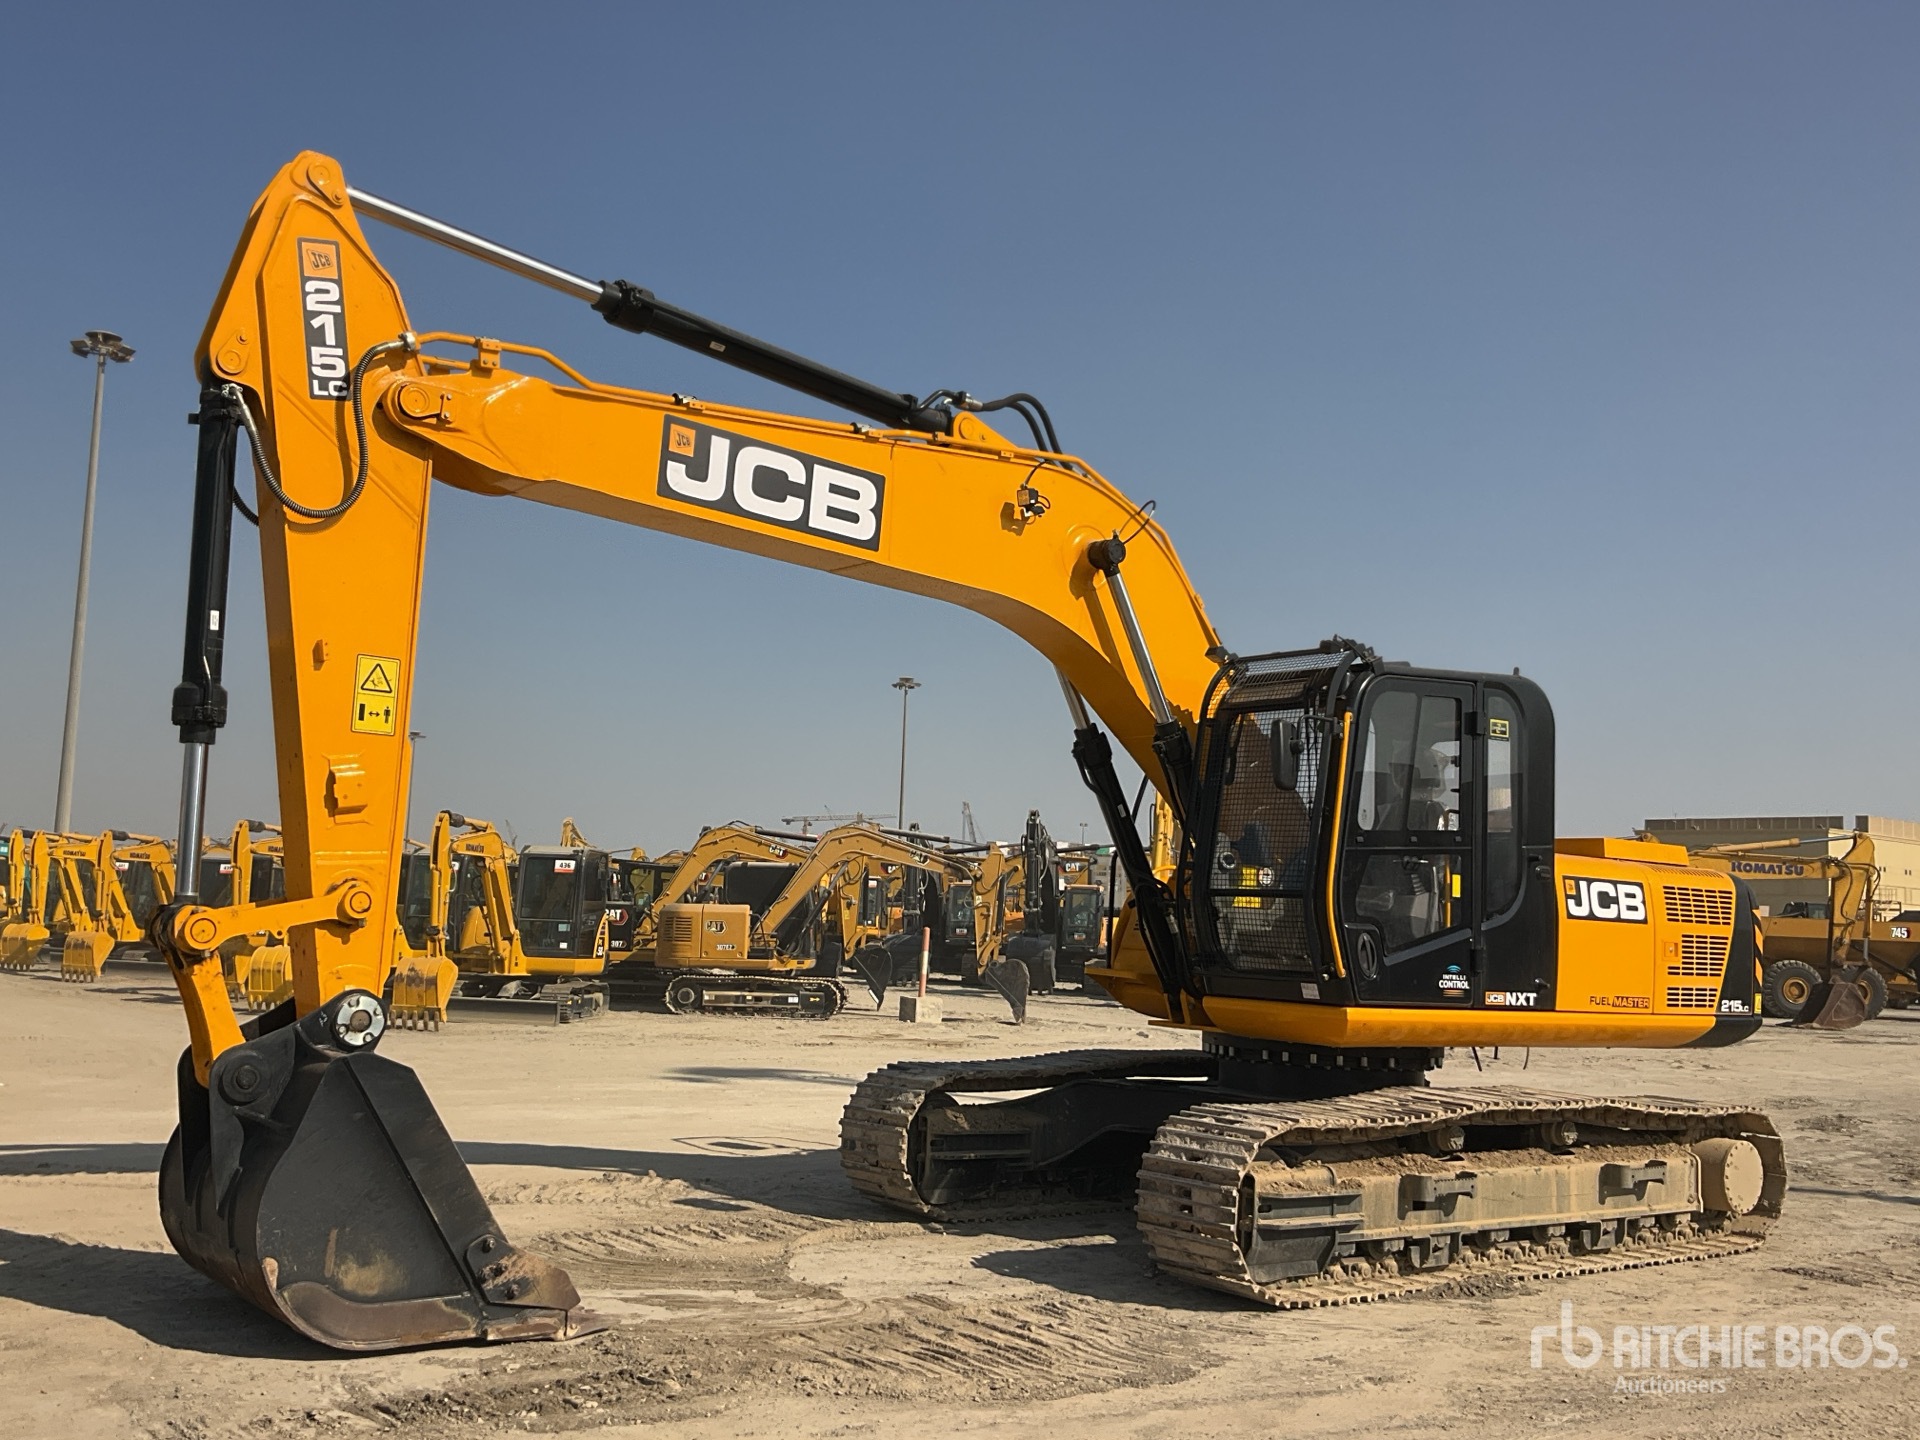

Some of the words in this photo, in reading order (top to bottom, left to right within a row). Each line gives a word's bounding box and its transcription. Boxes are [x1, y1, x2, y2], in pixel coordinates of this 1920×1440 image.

[311, 251, 332, 268] JCB
[304, 280, 346, 378] 215
[312, 379, 348, 397] LC
[675, 431, 691, 447] JCB
[666, 434, 878, 541] JCB
[63, 849, 87, 857] KOMATSU
[129, 851, 151, 860] KOMATSU
[559, 861, 571, 869] 436
[1065, 862, 1080, 872] CAT
[1731, 861, 1805, 876] KOMATSU
[1567, 880, 1646, 921] JCB
[1890, 927, 1908, 939] 745
[610, 940, 623, 949] 307
[1438, 980, 1470, 989] CONTROL
[1486, 993, 1505, 1003] JCB
[1505, 992, 1538, 1006] NXT
[1589, 996, 1612, 1006] FUEL
[1613, 997, 1649, 1008] MASTER
